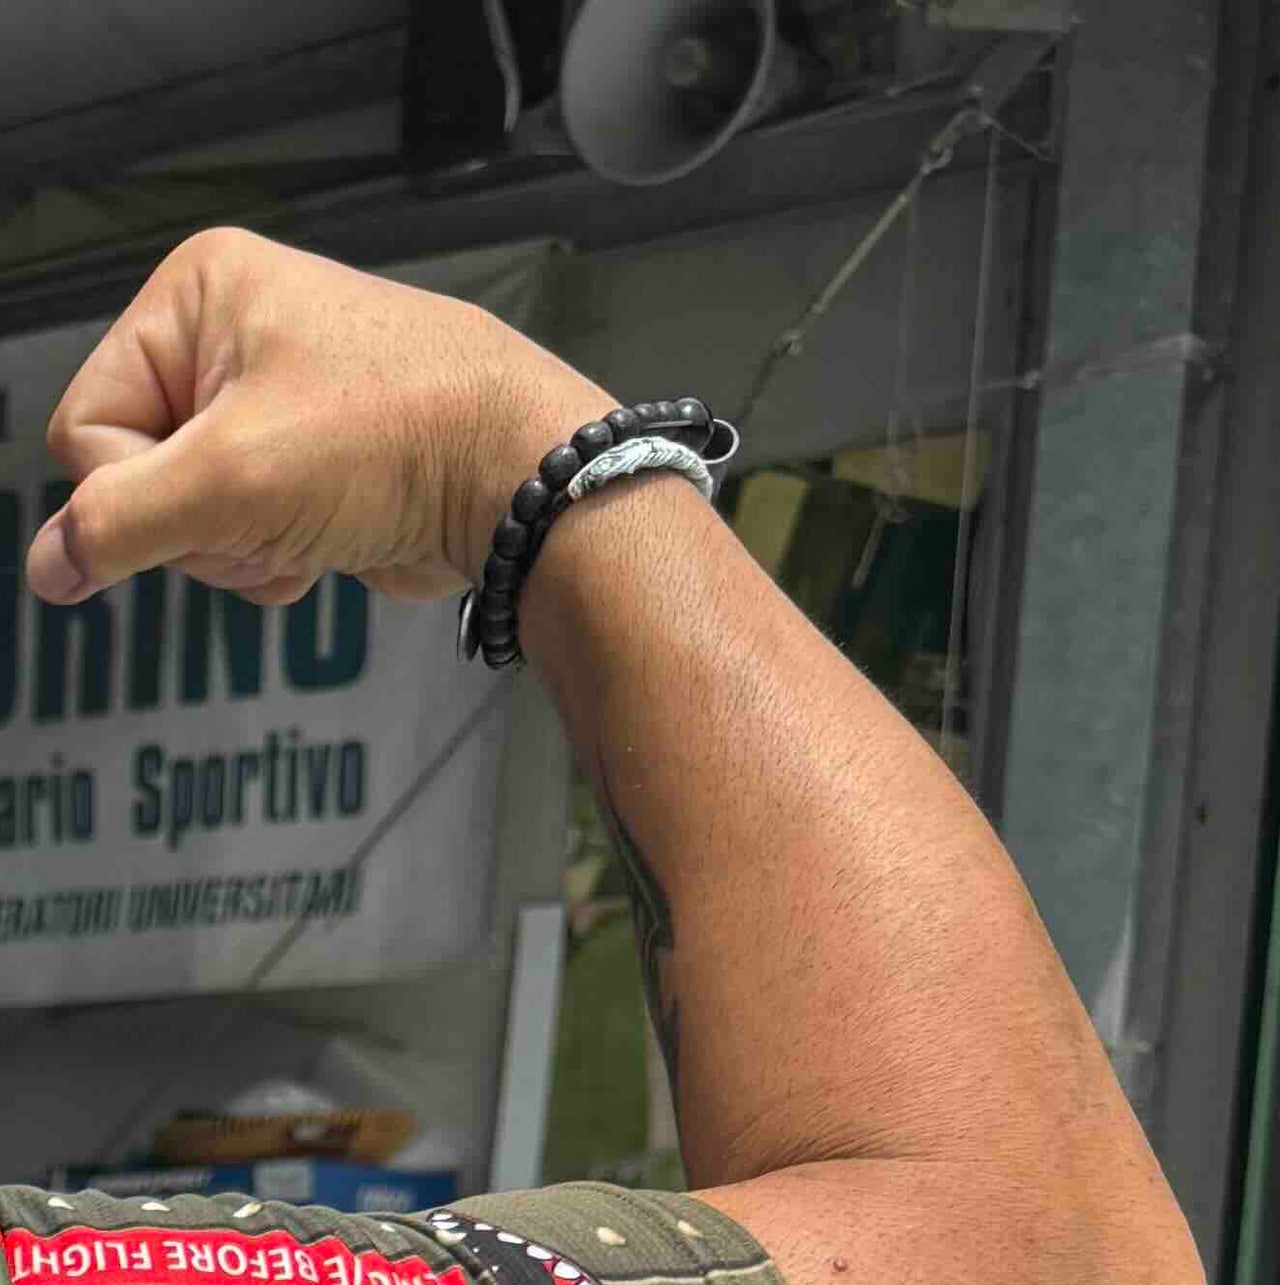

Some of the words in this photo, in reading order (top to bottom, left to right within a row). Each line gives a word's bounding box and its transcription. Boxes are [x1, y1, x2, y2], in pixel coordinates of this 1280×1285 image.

[130, 723, 367, 852] Sportivo
[11, 1239, 153, 1285] FLIGHT
[162, 1239, 321, 1284] BEFORE
